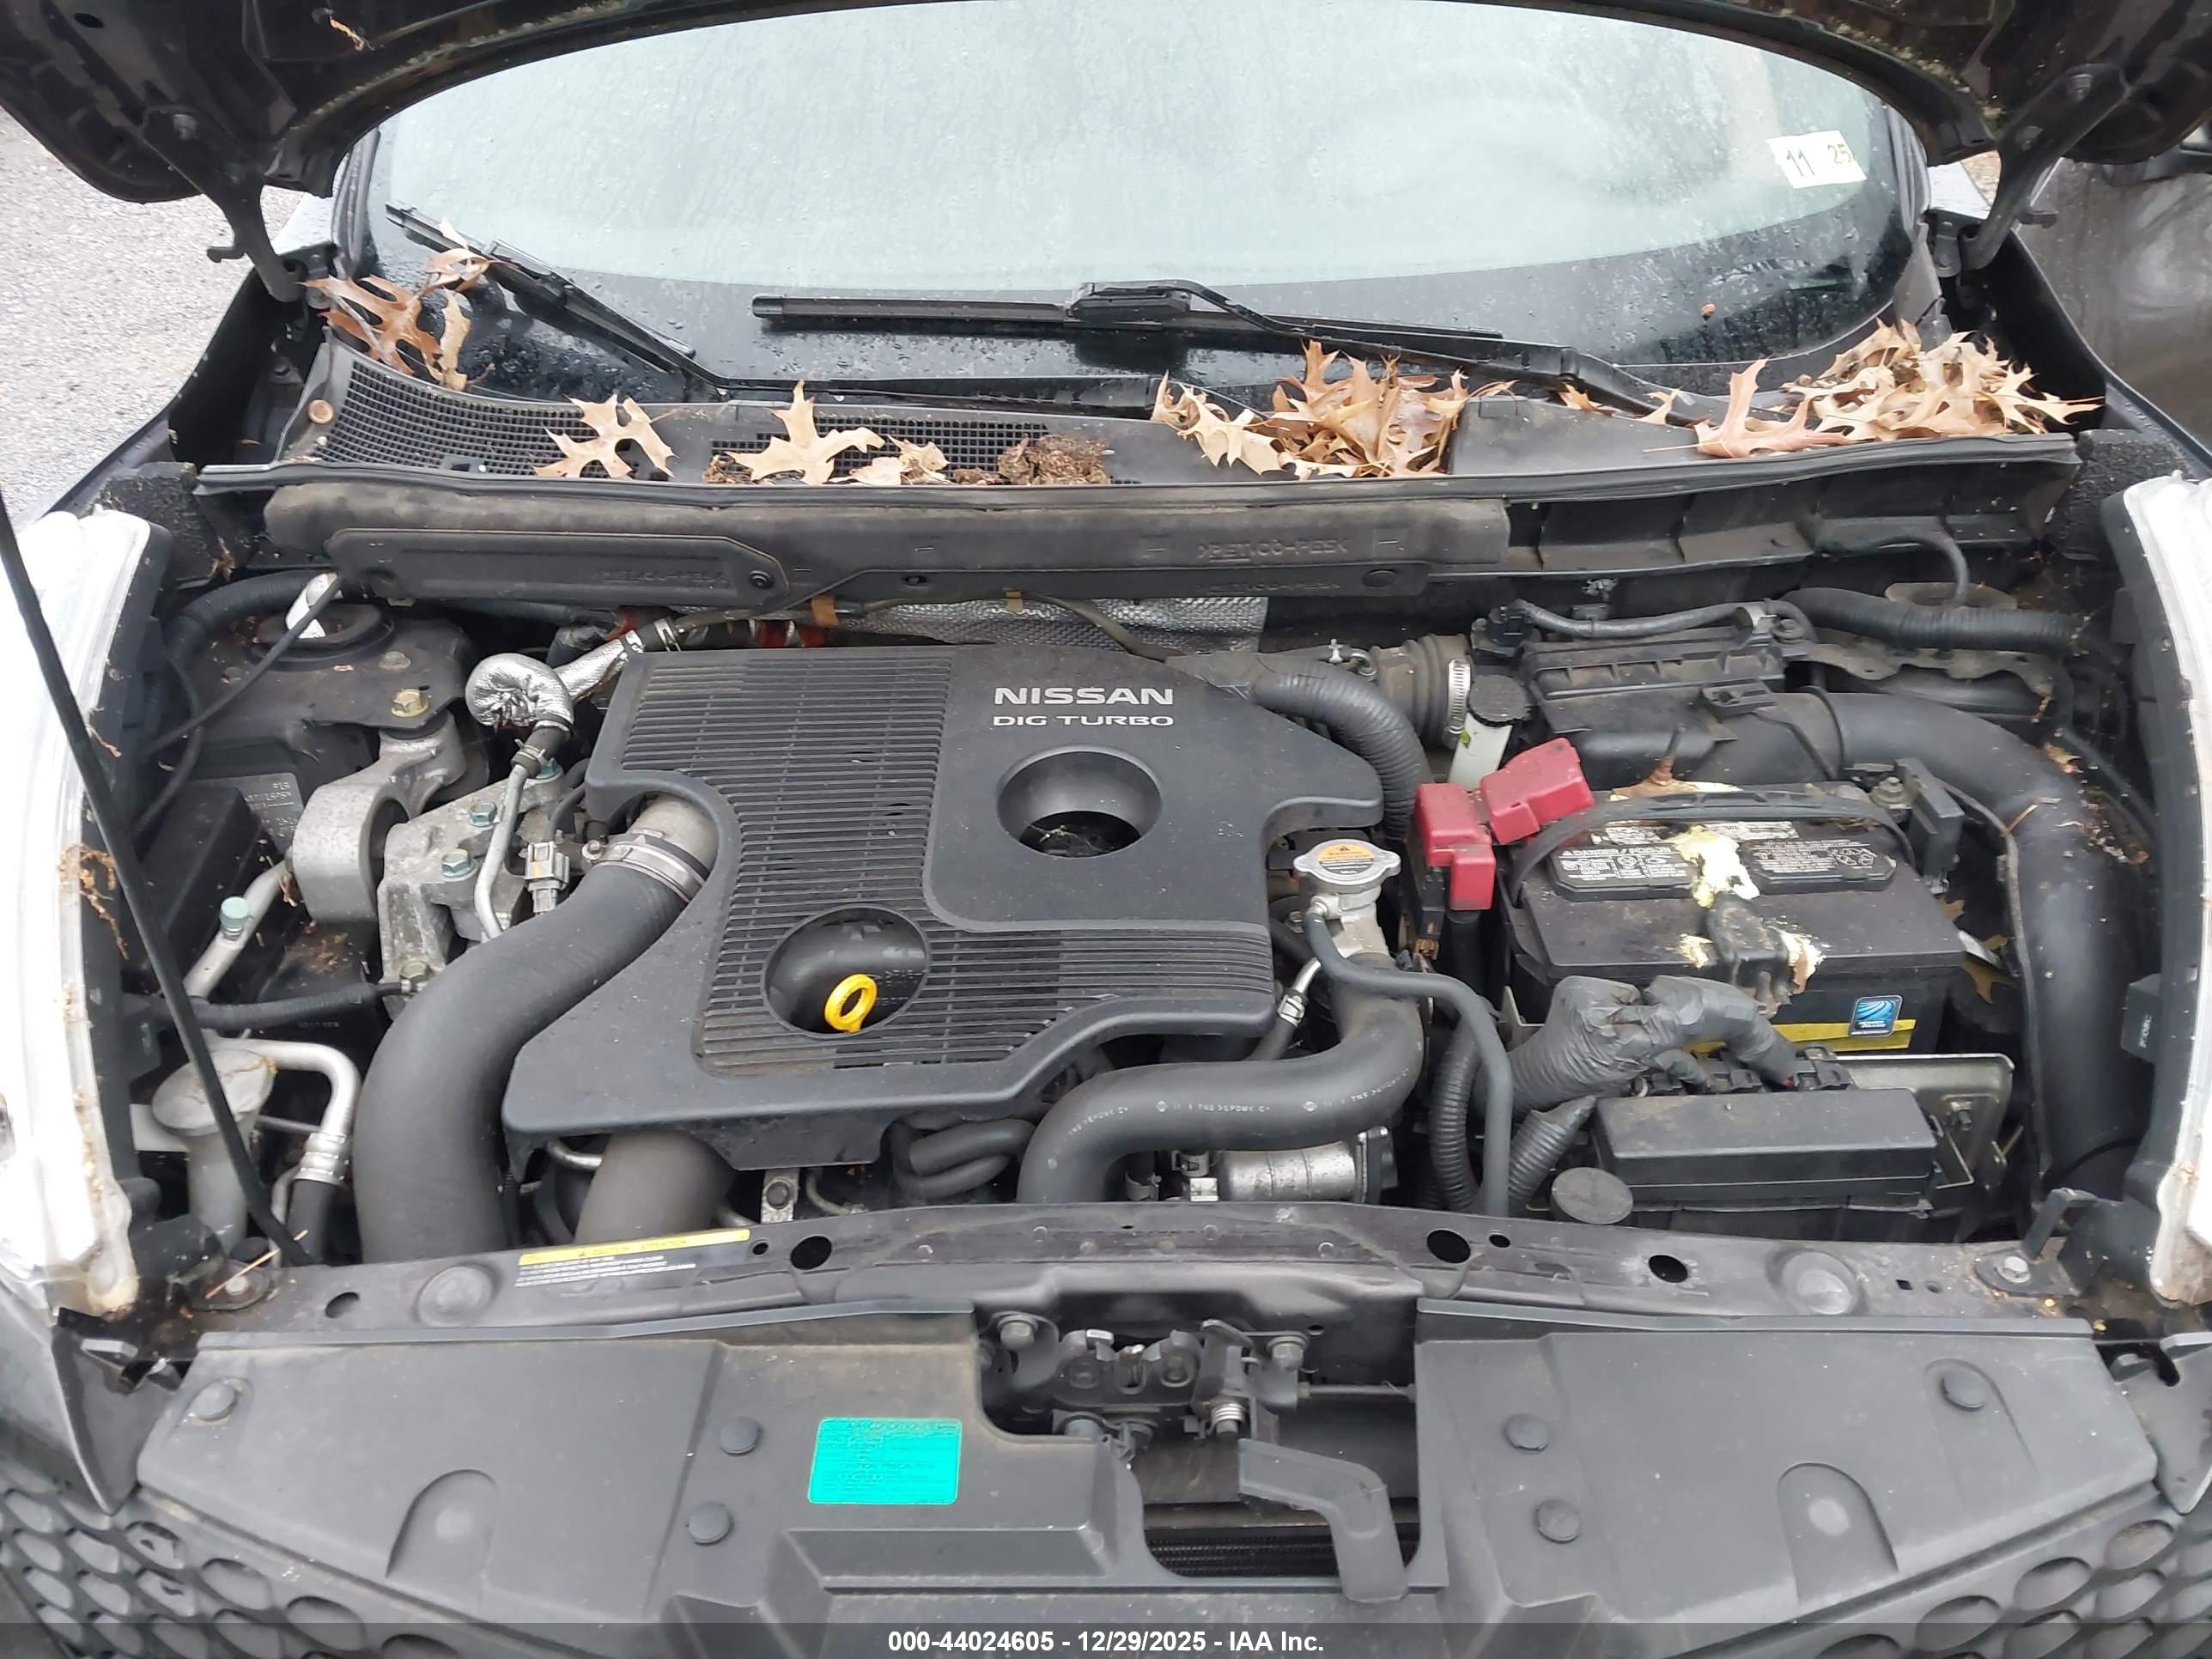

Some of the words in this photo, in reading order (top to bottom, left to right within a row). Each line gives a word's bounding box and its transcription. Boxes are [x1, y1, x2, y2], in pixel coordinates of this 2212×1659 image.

[1787, 149, 1815, 177] 11
[1827, 143, 1852, 164] 25
[993, 687, 1174, 705] NISSAN
[993, 715, 1047, 726] DIG
[1055, 715, 1174, 726] TURBO
